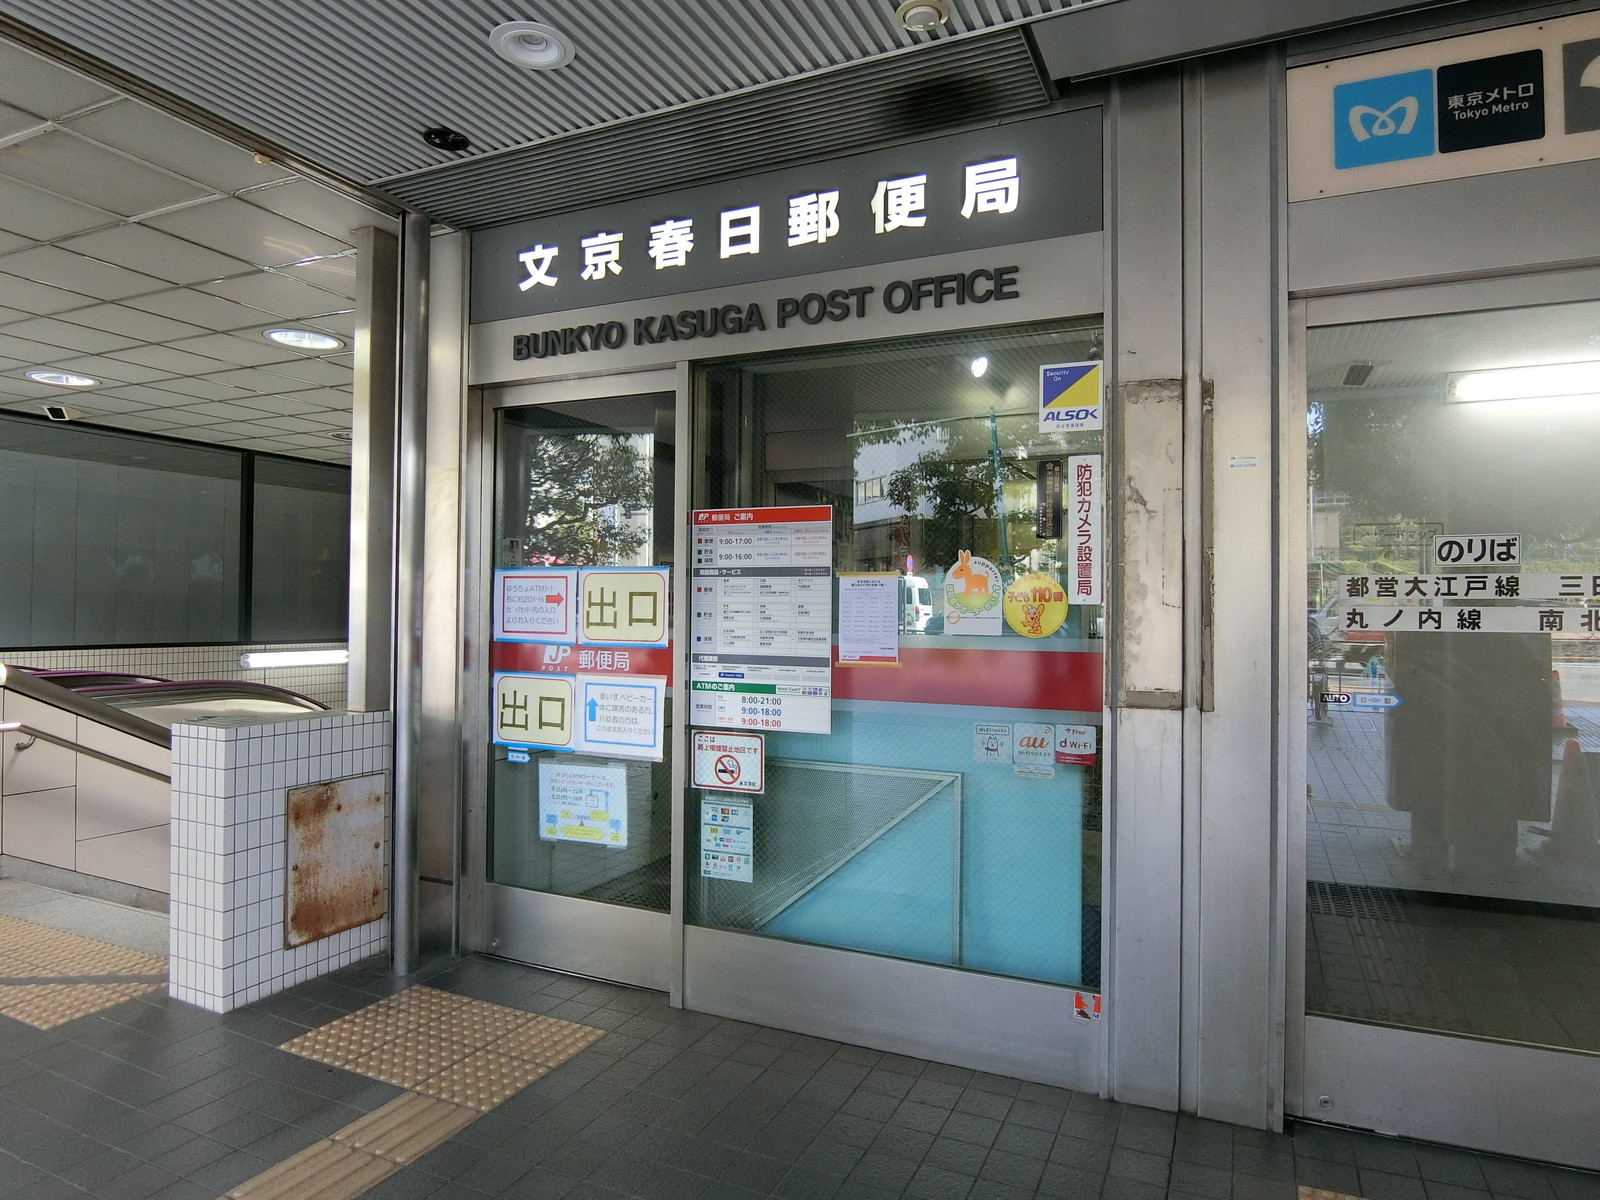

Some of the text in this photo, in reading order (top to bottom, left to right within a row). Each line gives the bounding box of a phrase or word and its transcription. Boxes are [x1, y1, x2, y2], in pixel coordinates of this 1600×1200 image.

[1447, 83, 1534, 110] 東京メトロ
[1453, 100, 1530, 121] Tokyo Metro
[518, 157, 1020, 292] 文京春日郵便局
[513, 265, 1021, 362] BUNKYO KASUGA POST OFFICE
[1043, 409, 1099, 422] ALSOK
[733, 512, 754, 521] ご案内
[1076, 464, 1093, 597] 防犯カメラ設置局
[718, 537, 753, 546] 9:00-17:00
[1437, 537, 1518, 563] のりば
[718, 553, 753, 561] 9:00-16:00
[974, 560, 1000, 583] supporter
[1345, 575, 1521, 599] 都営大江戸線
[586, 587, 658, 629] 出口
[1345, 608, 1483, 631] 丸ノ内線
[578, 650, 630, 671] 郵便局
[741, 696, 782, 706] 8:00-21:00
[1322, 694, 1348, 702] AUTO
[500, 690, 566, 731] 出口
[741, 706, 782, 717] 9:00-18:00
[741, 717, 782, 728] 9:00-18:00
[697, 735, 716, 743] ここは
[1072, 728, 1087, 736] Free
[1018, 735, 1050, 749] au
[1059, 738, 1092, 750] d Wi-Fi
